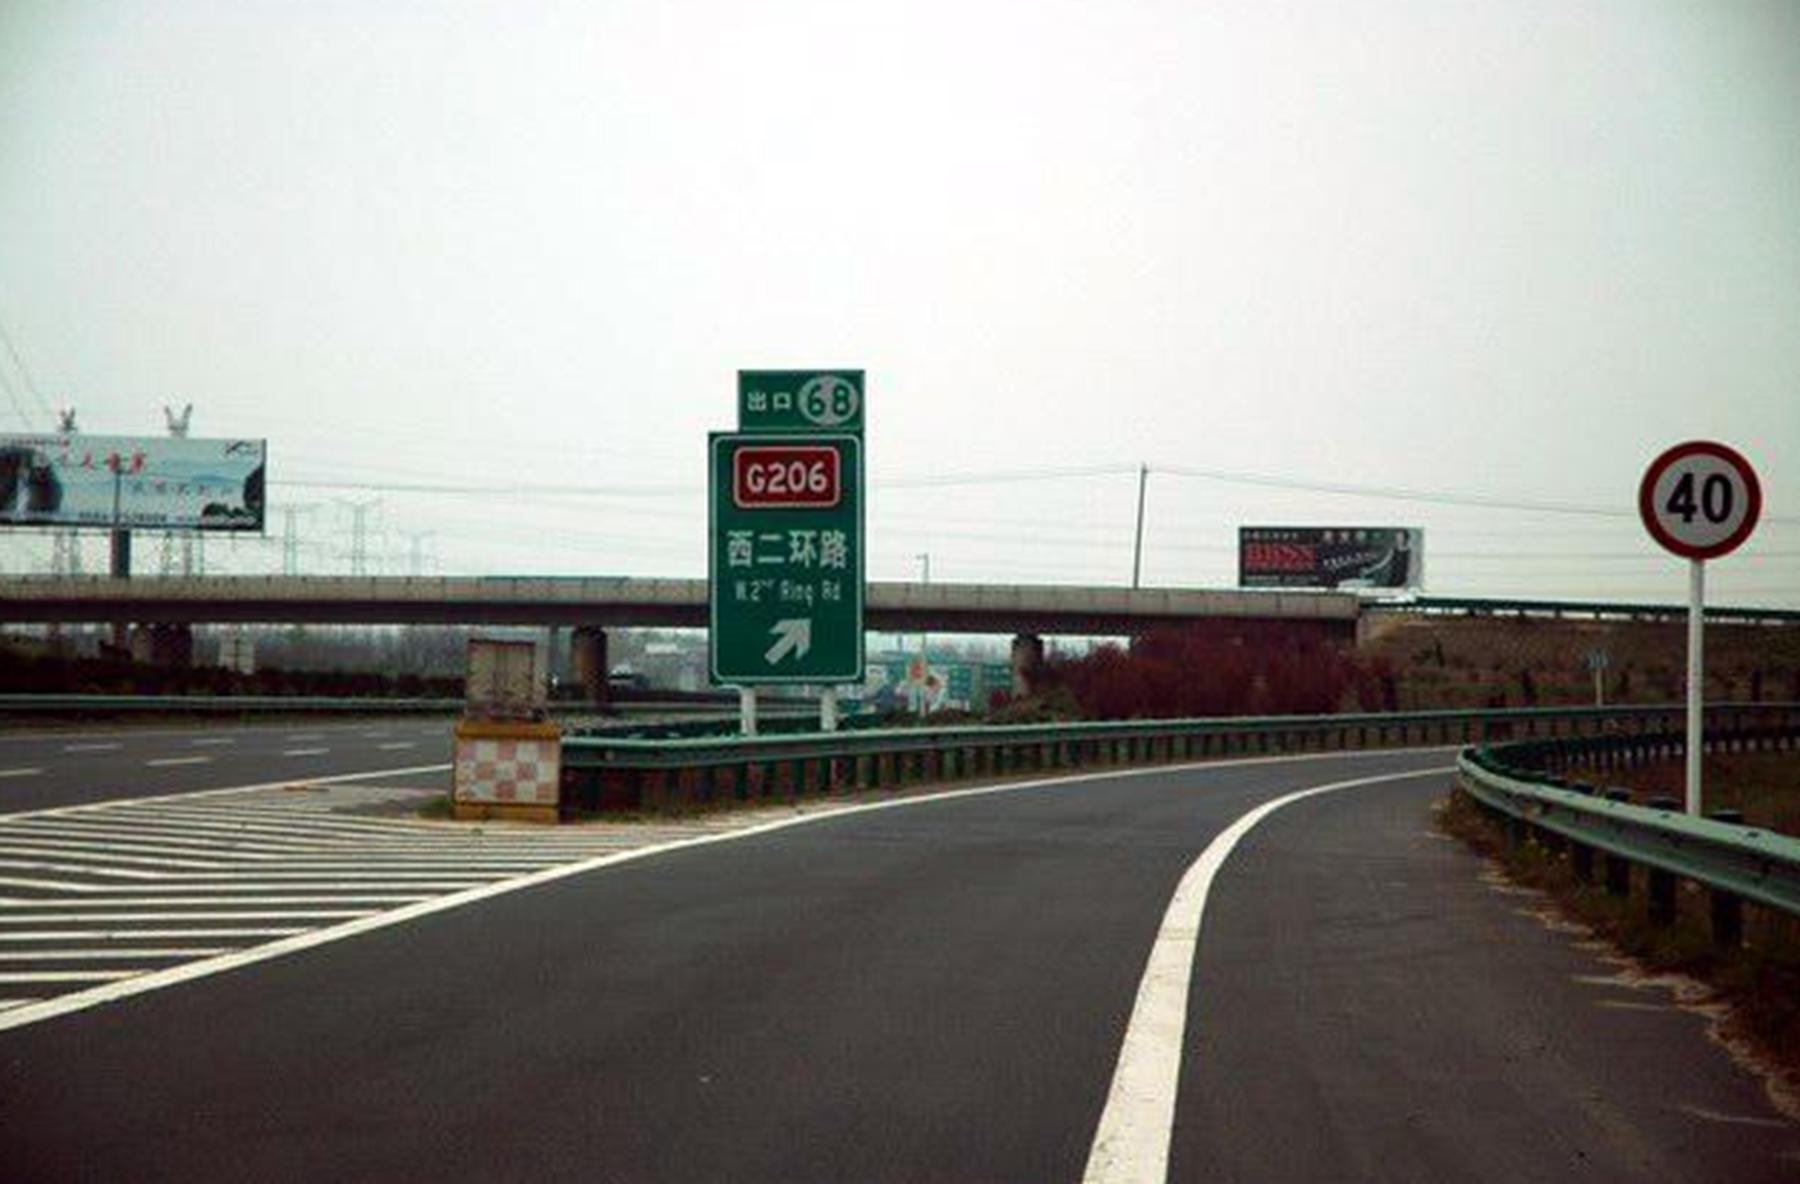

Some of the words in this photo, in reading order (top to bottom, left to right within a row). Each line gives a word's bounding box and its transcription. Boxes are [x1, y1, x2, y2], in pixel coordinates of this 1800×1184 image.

[747, 391, 791, 411] 出口
[808, 384, 849, 414] 68
[747, 462, 828, 492] G206
[1666, 472, 1733, 524] 40
[727, 529, 848, 569] 西二环路
